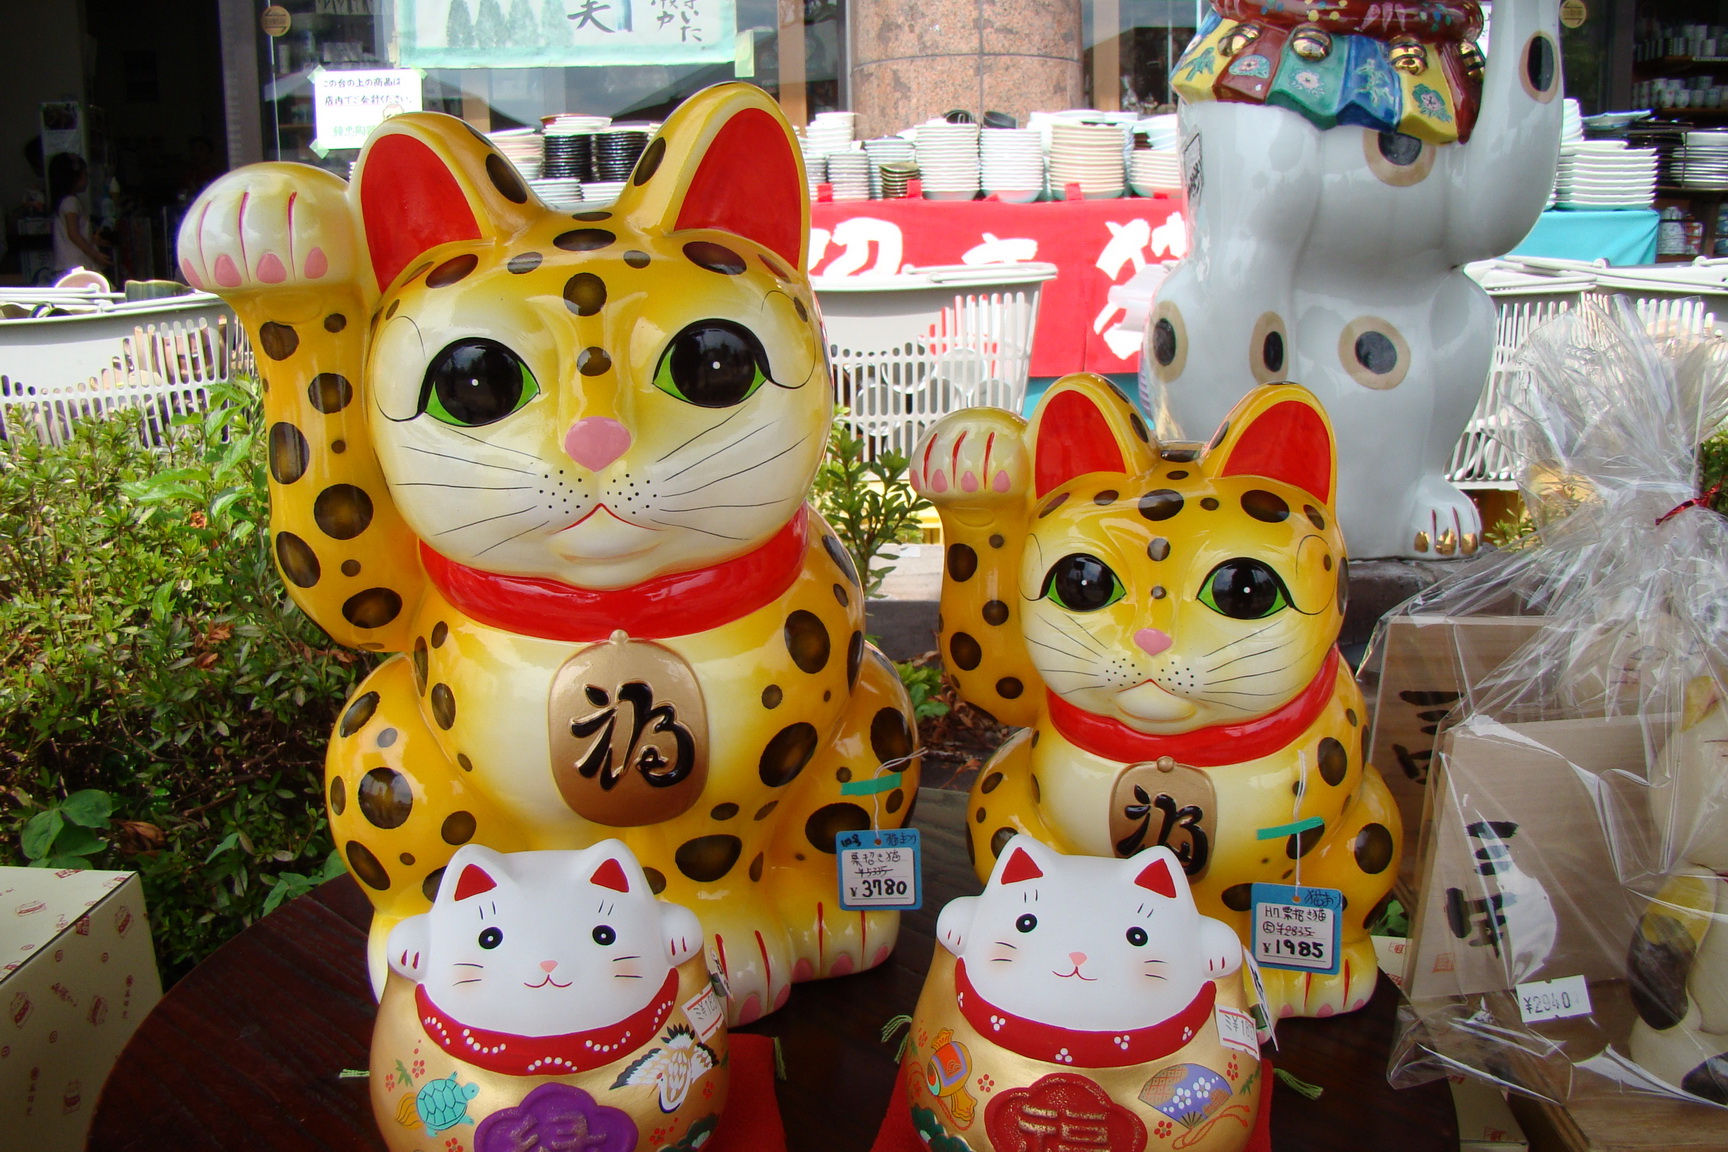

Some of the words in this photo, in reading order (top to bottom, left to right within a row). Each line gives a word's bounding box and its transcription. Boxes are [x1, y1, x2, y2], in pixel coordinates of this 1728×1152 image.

[323, 77, 401, 88] この台の上の商品は
[850, 878, 908, 898] ¥3780
[1262, 938, 1324, 959] ¥1985
[1523, 991, 1571, 1014] ¥2940
